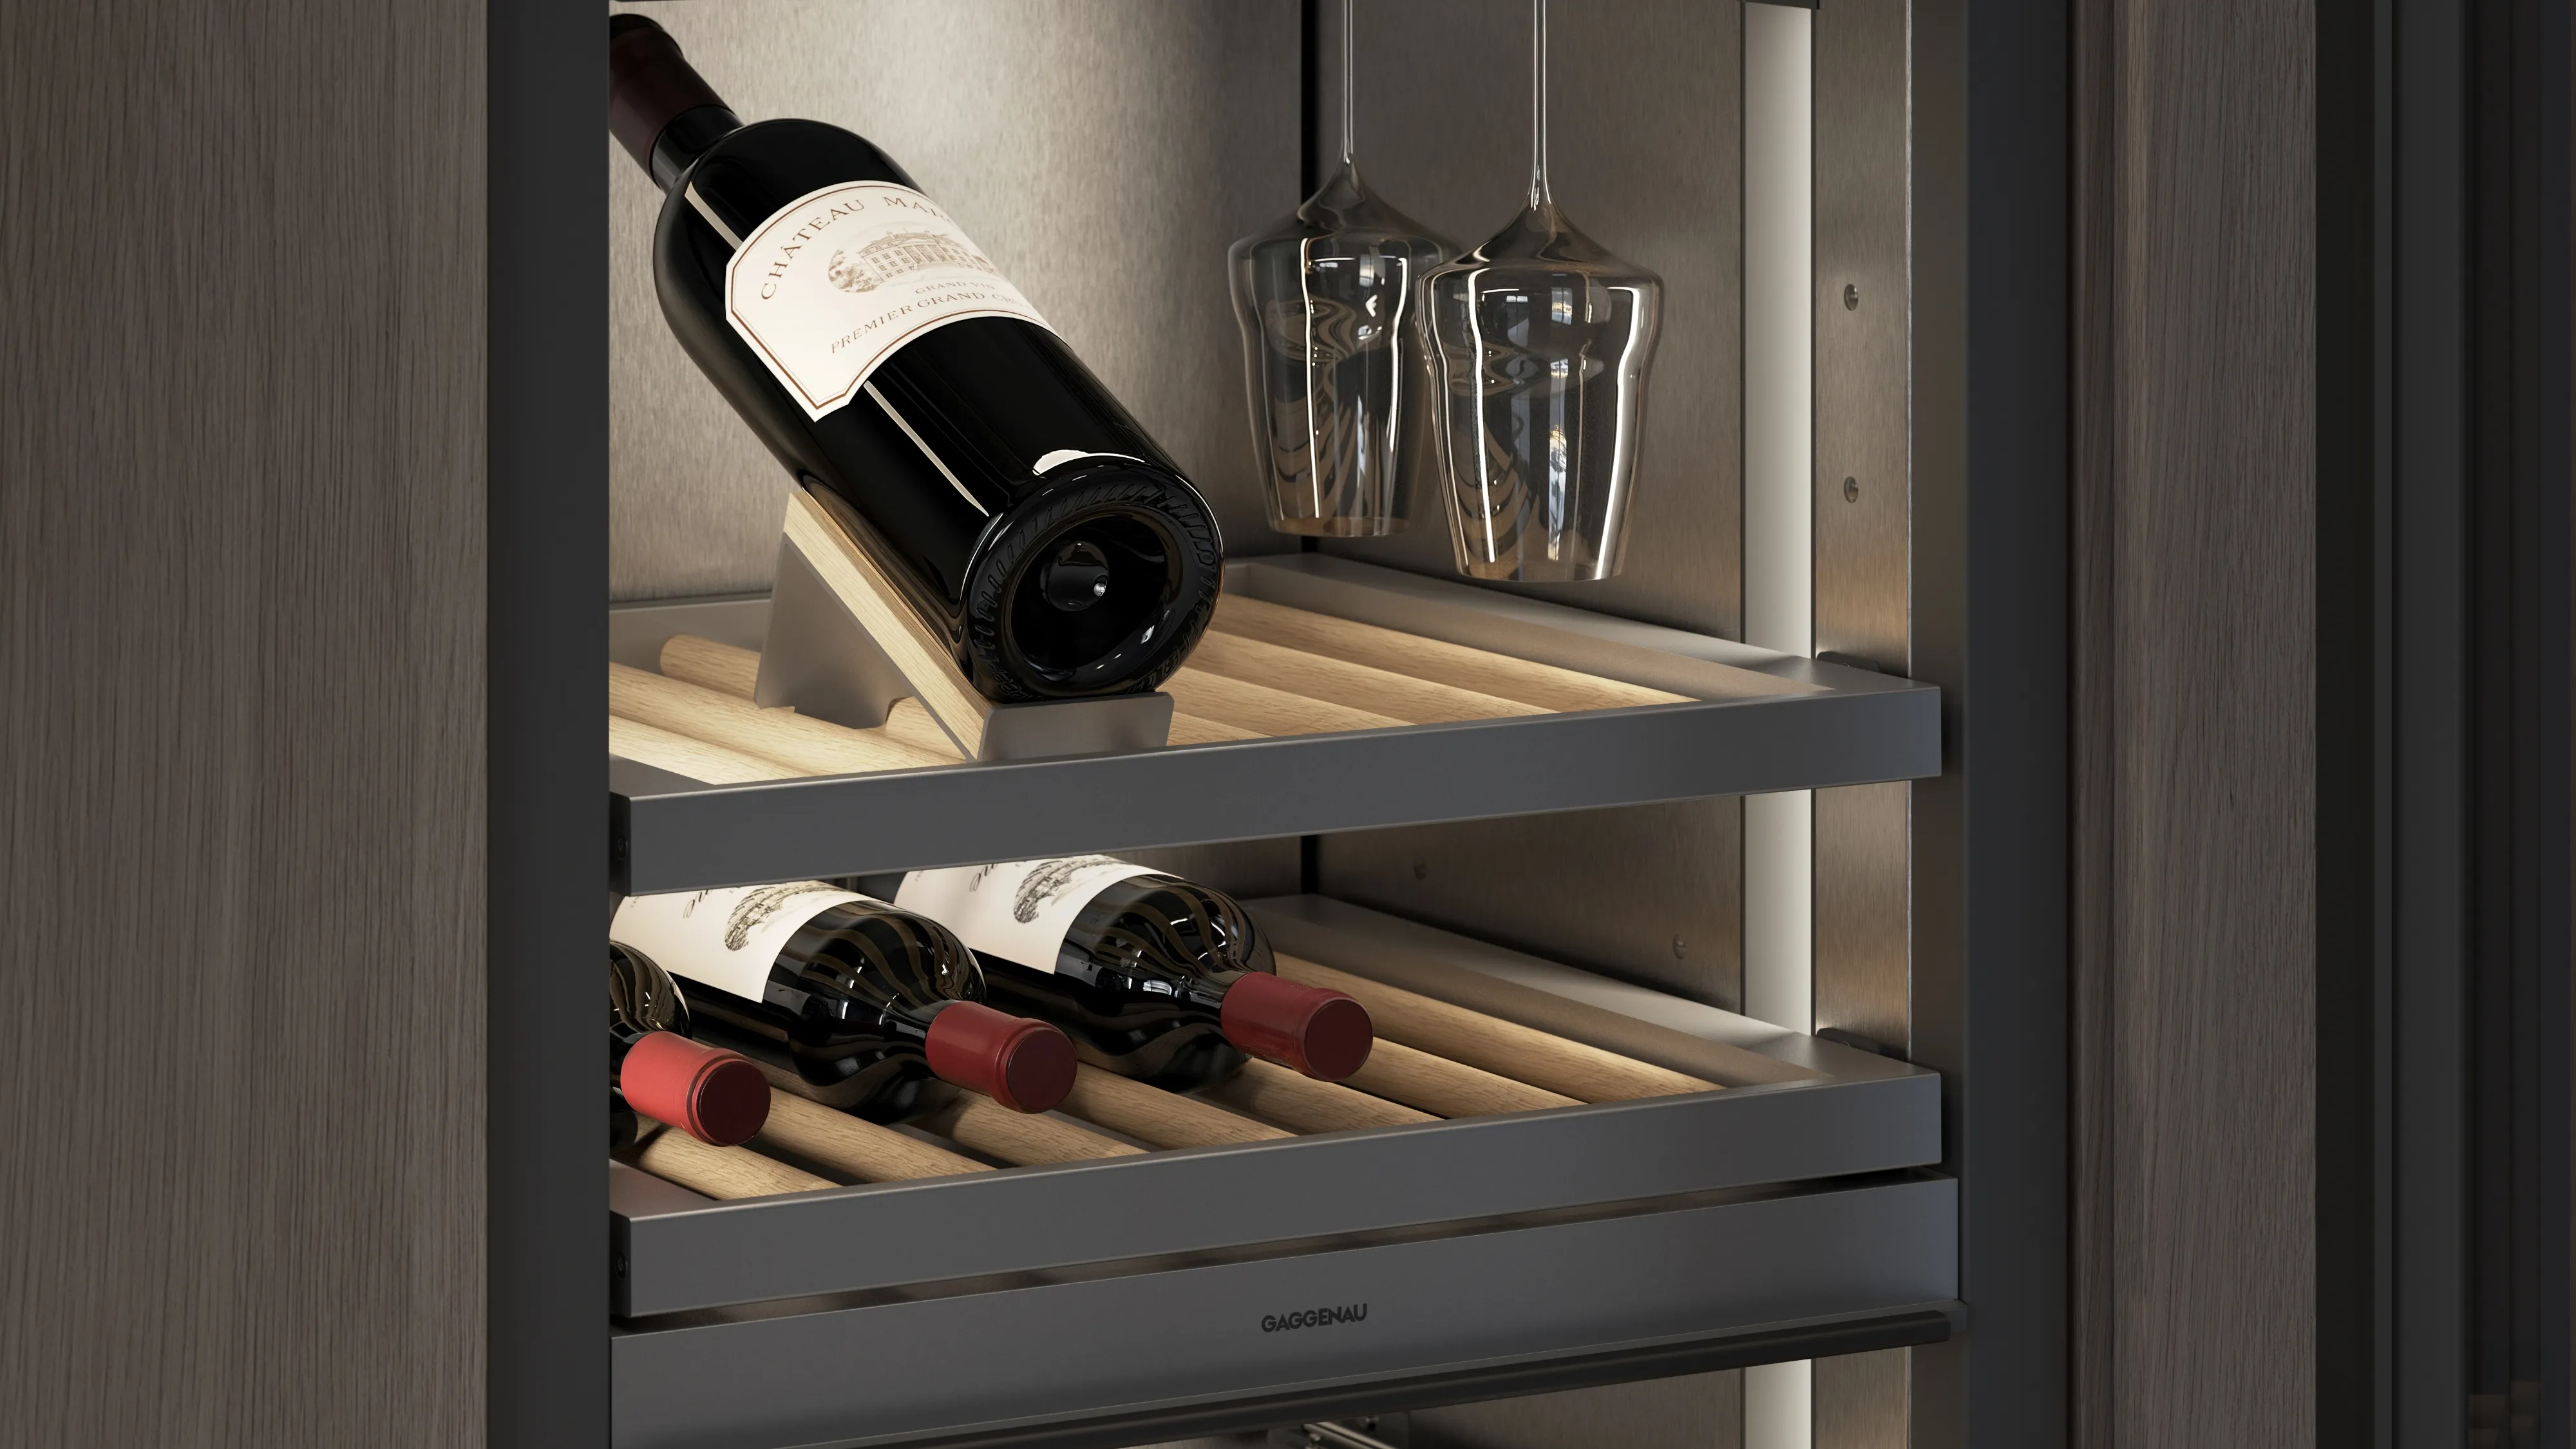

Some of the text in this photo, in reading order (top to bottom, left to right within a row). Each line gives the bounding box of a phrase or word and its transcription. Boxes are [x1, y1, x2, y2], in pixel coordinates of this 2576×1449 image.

[761, 198, 866, 300] CHÂTEAU
[915, 281, 996, 294] GRAND VIN
[831, 305, 913, 354] PREMIER
[916, 291, 985, 308] GRAND
[1261, 1303, 1368, 1333] GAGGENAU
